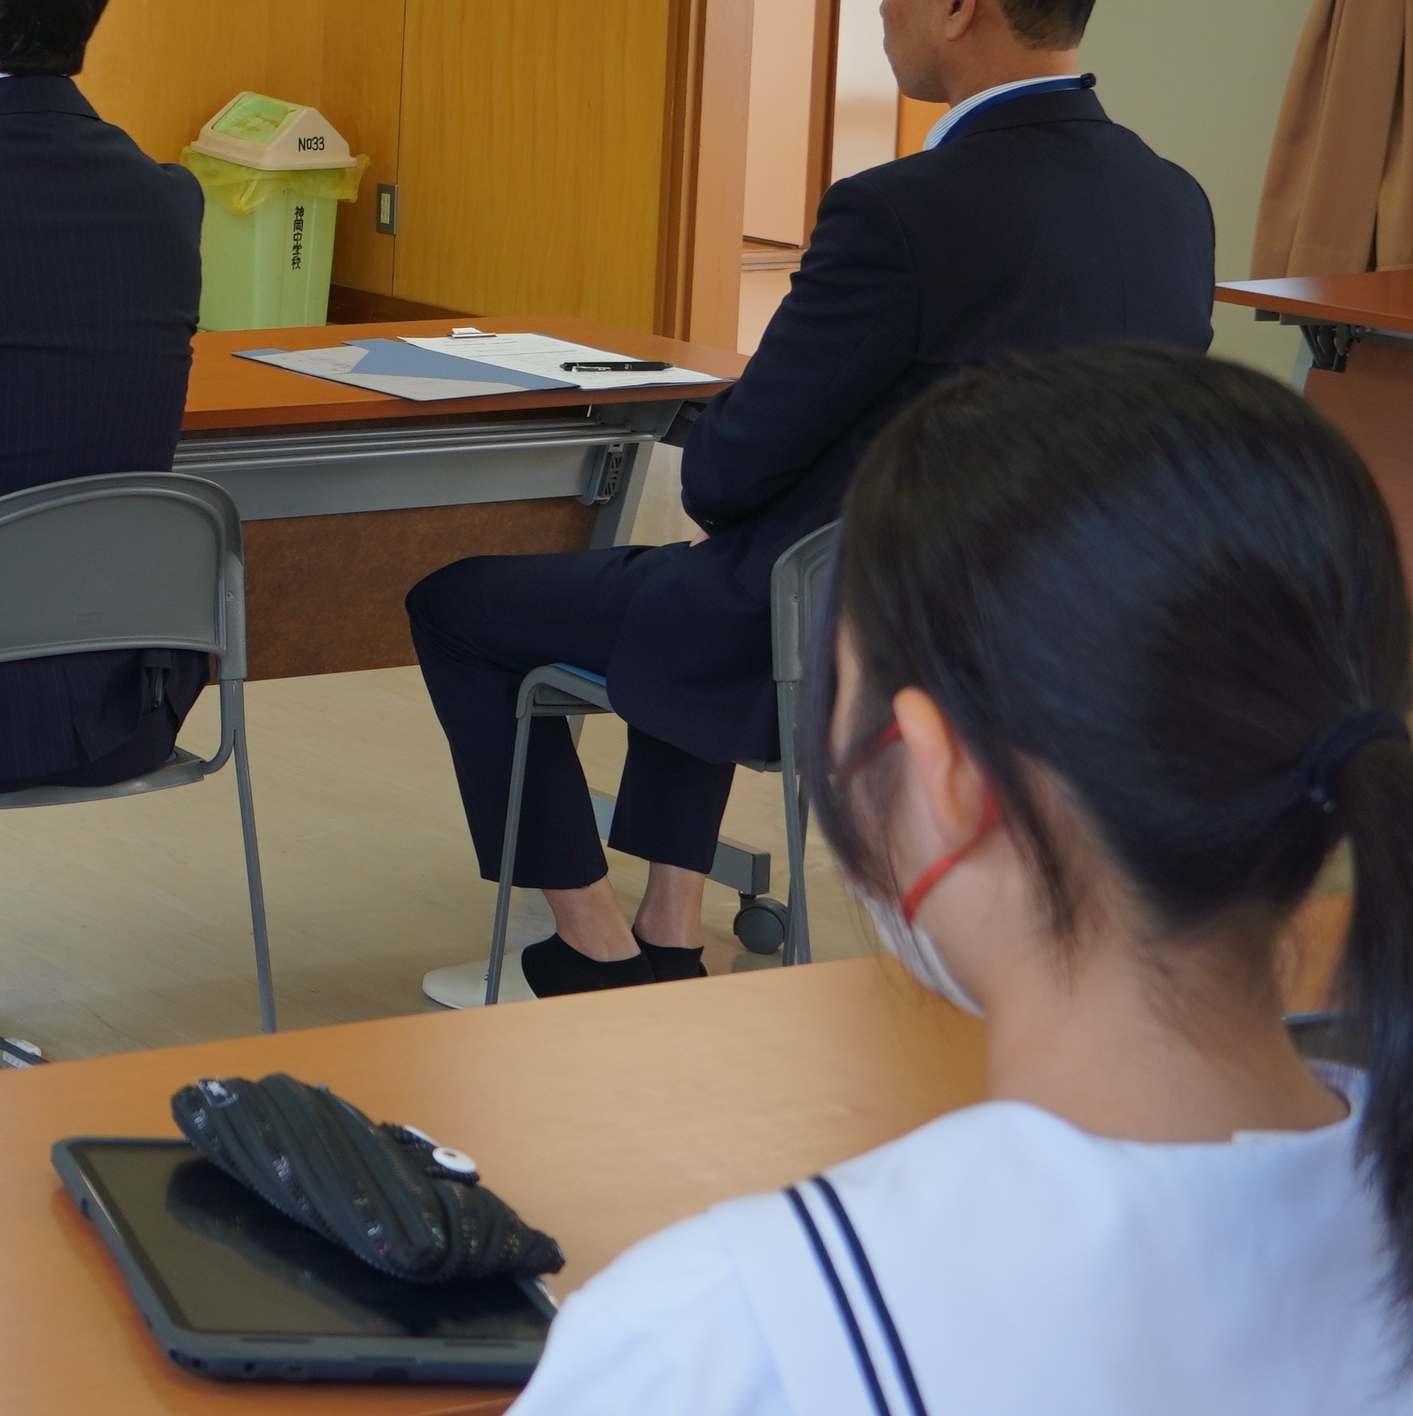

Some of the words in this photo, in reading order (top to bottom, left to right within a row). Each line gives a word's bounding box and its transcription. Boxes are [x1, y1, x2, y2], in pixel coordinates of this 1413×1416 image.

[291, 206, 304, 270] 神岡中学校
